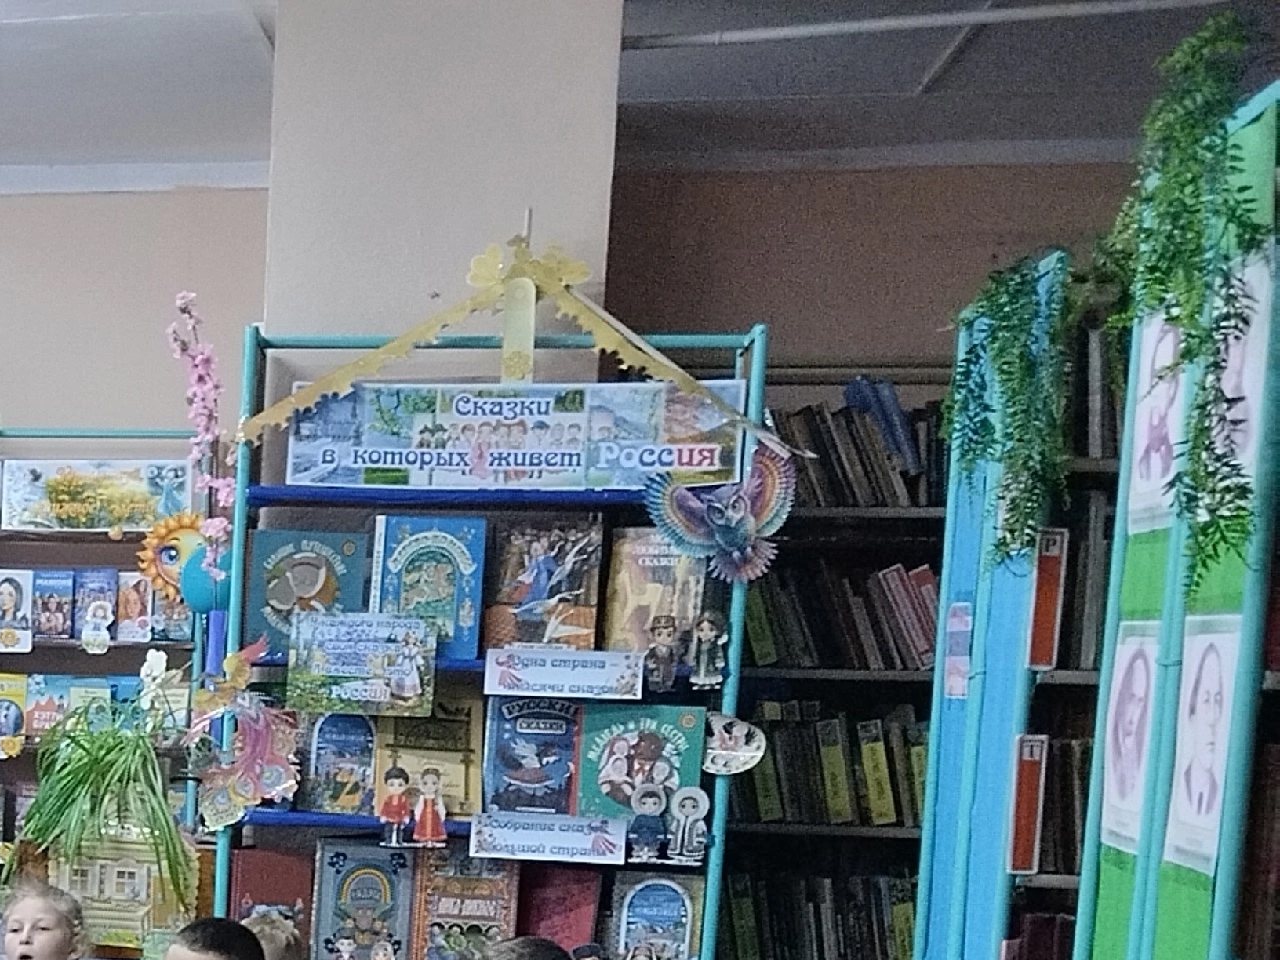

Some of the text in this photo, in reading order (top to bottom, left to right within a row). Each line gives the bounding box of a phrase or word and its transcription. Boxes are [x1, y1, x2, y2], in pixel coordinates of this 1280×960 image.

[454, 395, 552, 421] Сказки
[321, 444, 719, 470] в которых живет Россия
[331, 684, 390, 700] Россия
